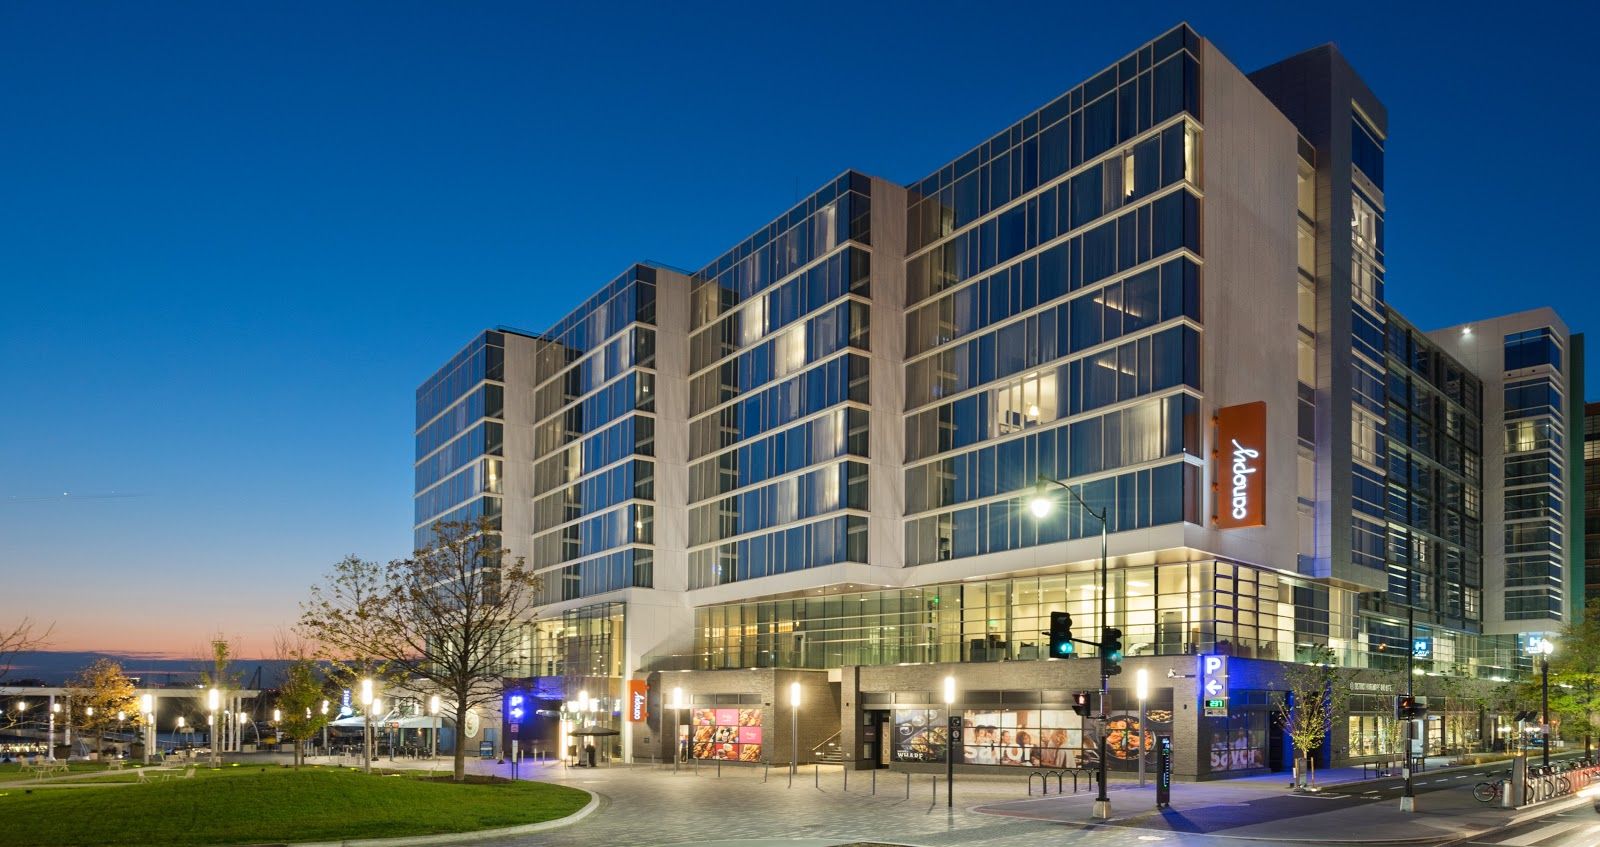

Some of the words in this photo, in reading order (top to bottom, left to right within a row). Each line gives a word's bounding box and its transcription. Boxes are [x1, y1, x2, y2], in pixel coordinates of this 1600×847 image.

[1231, 438, 1260, 520] canopy
[1206, 657, 1222, 675] P
[511, 696, 524, 707] P
[633, 691, 645, 720] canopy
